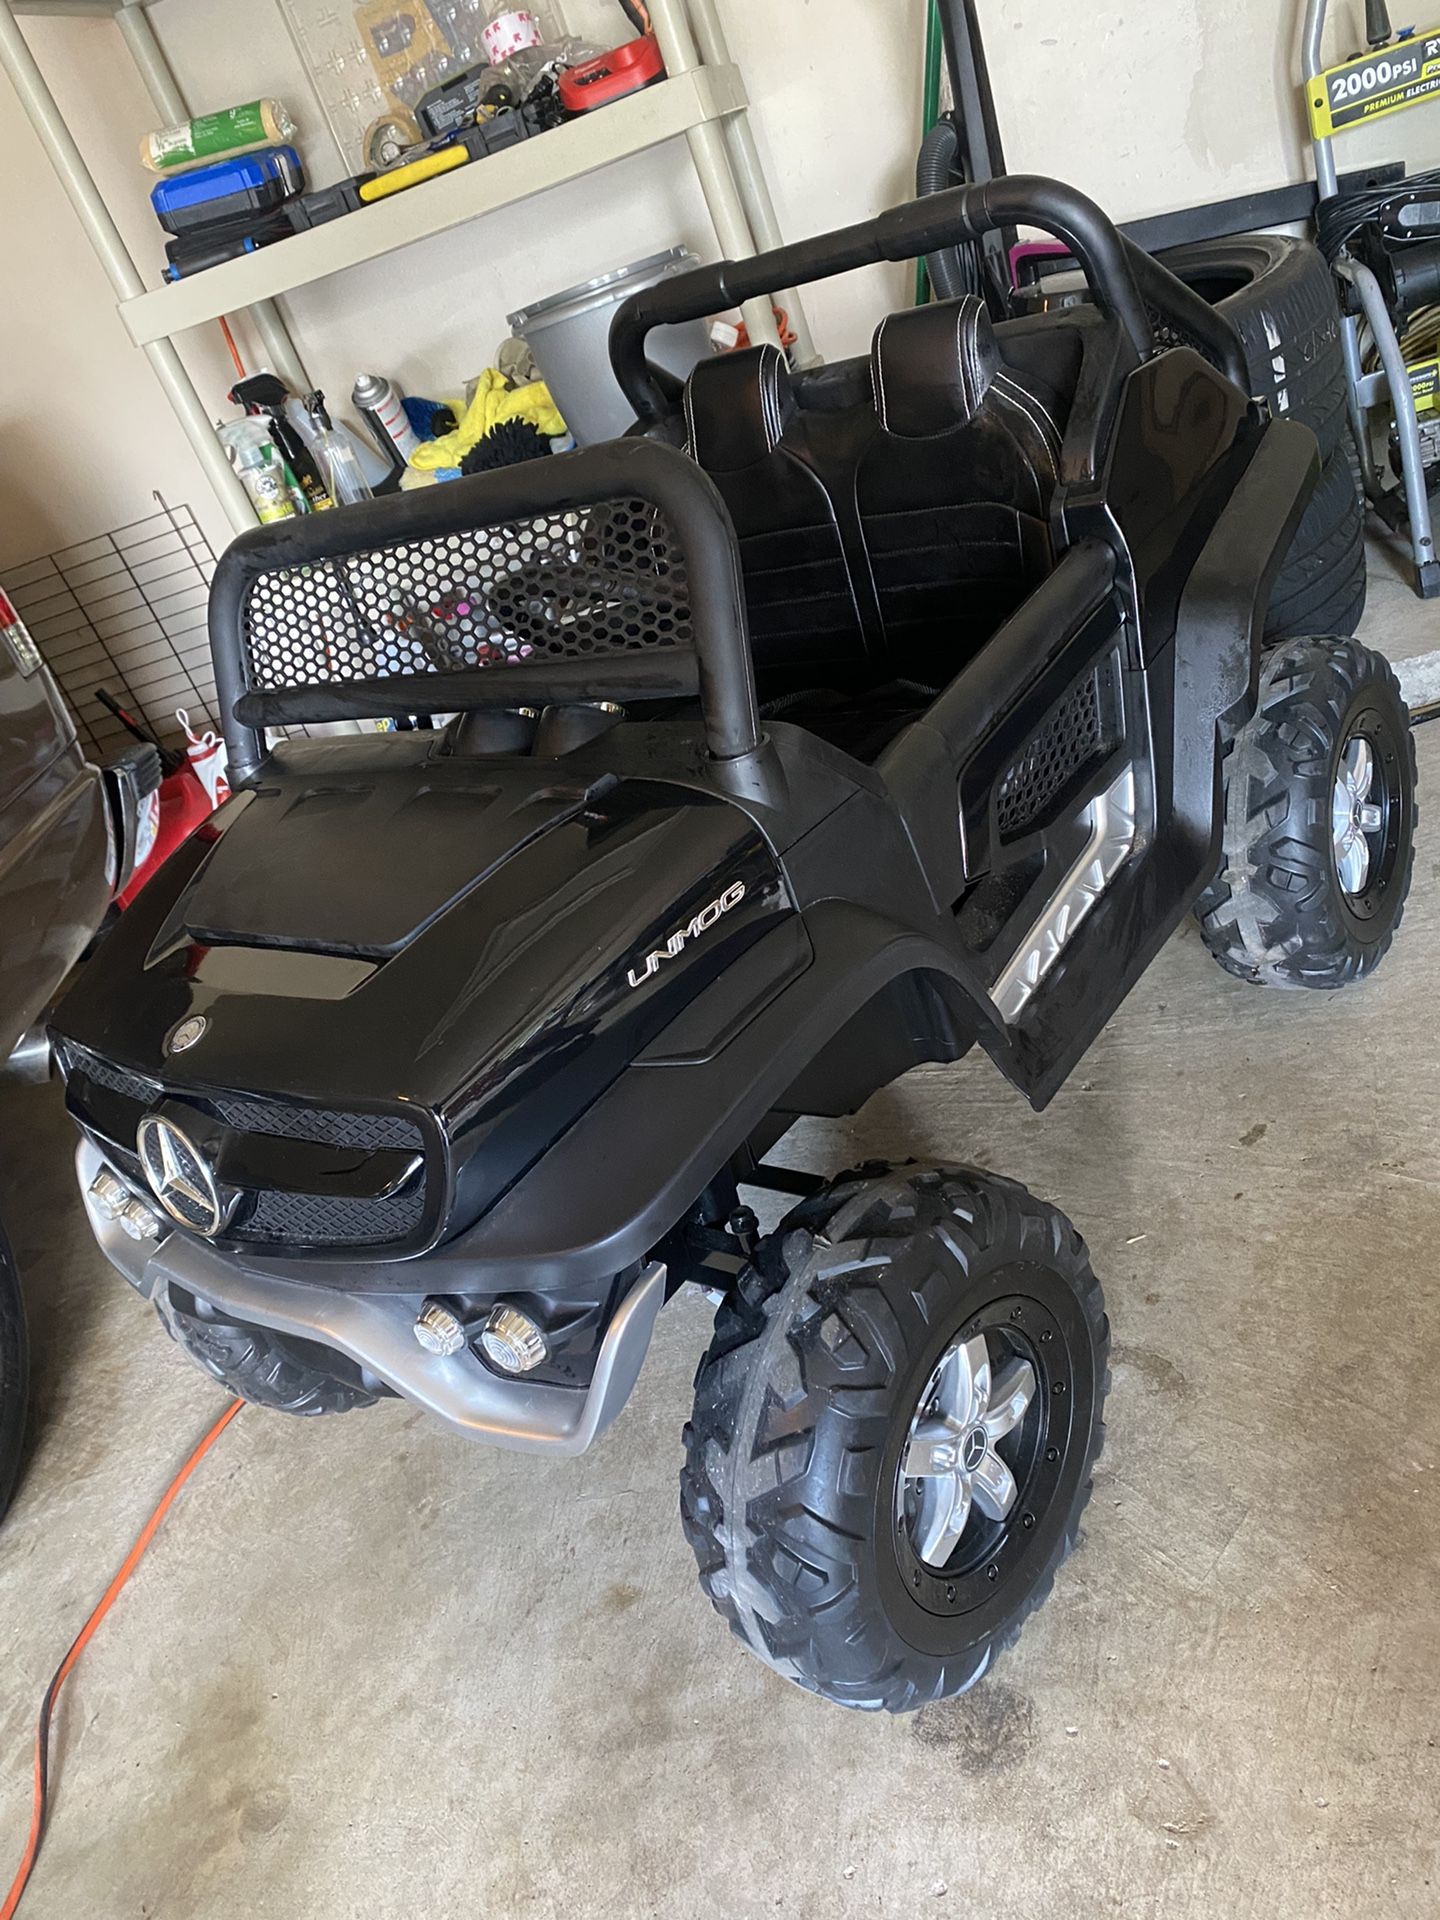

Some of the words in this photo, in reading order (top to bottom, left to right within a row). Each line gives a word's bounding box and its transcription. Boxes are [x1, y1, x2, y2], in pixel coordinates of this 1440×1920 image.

[1332, 58, 1417, 102] 2000PSI
[1364, 92, 1404, 113] PREMIUM
[627, 881, 746, 987] UNIMOG
